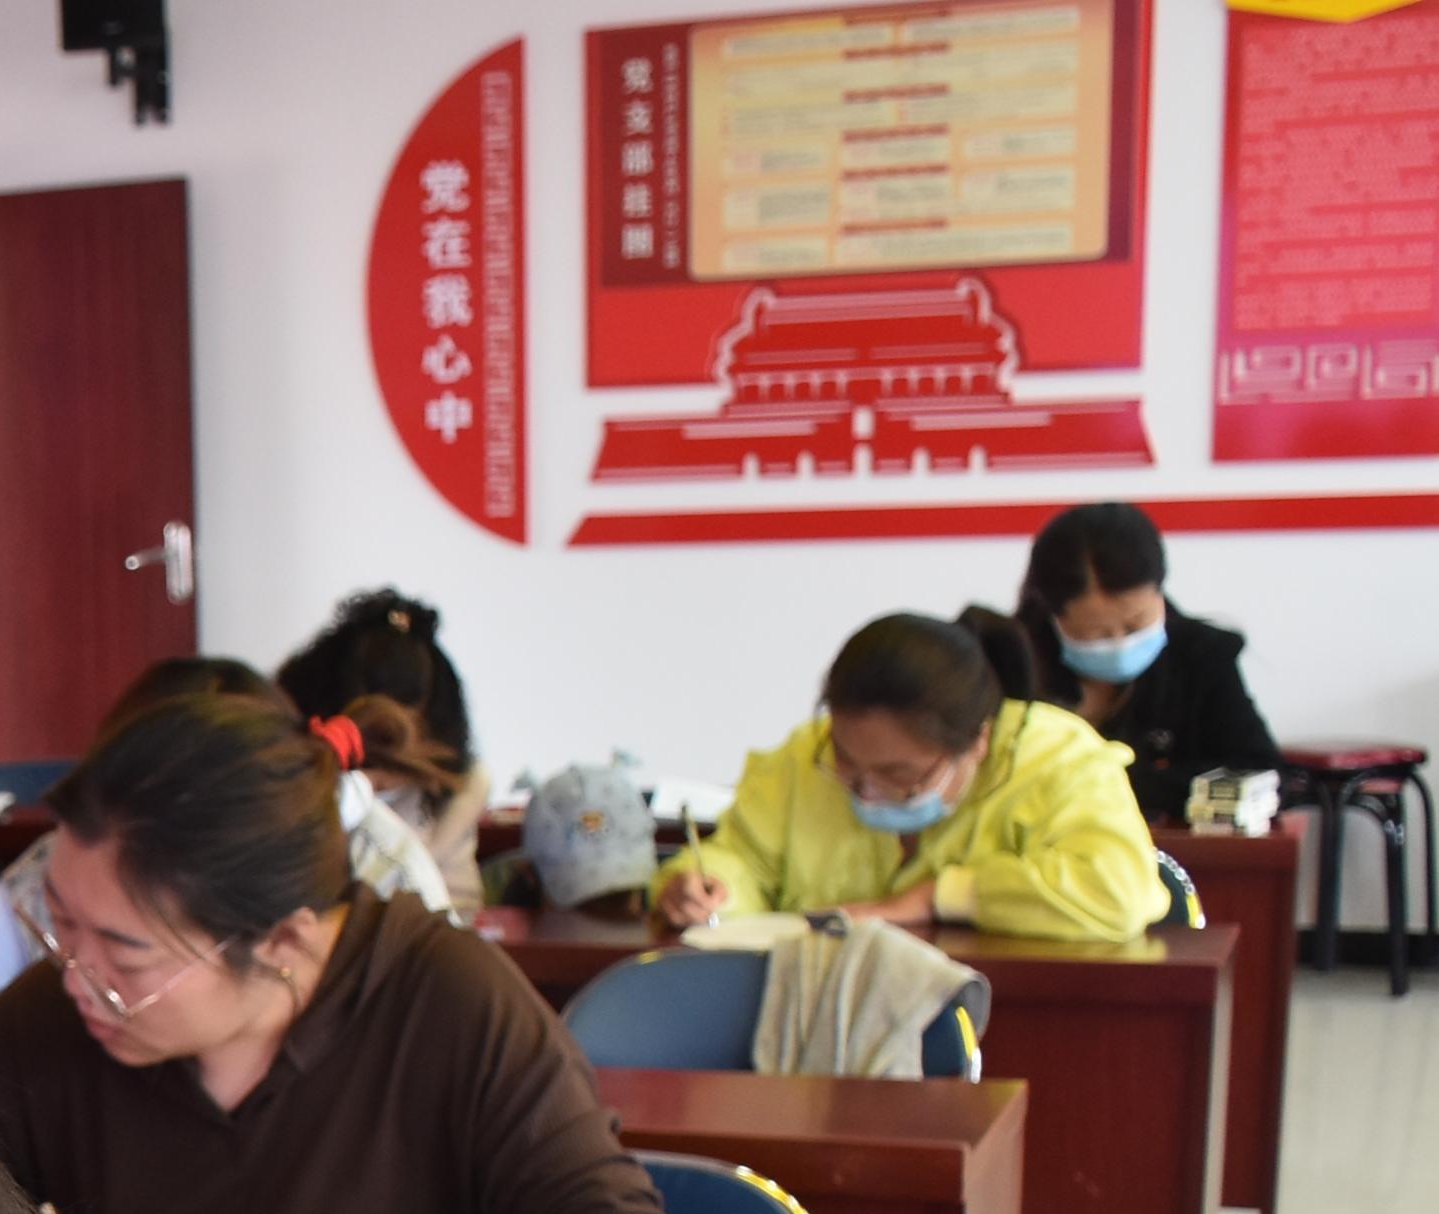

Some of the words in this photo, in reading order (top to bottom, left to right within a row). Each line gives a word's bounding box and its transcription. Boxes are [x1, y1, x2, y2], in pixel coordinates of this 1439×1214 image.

[420, 160, 473, 444] 党在我心中
